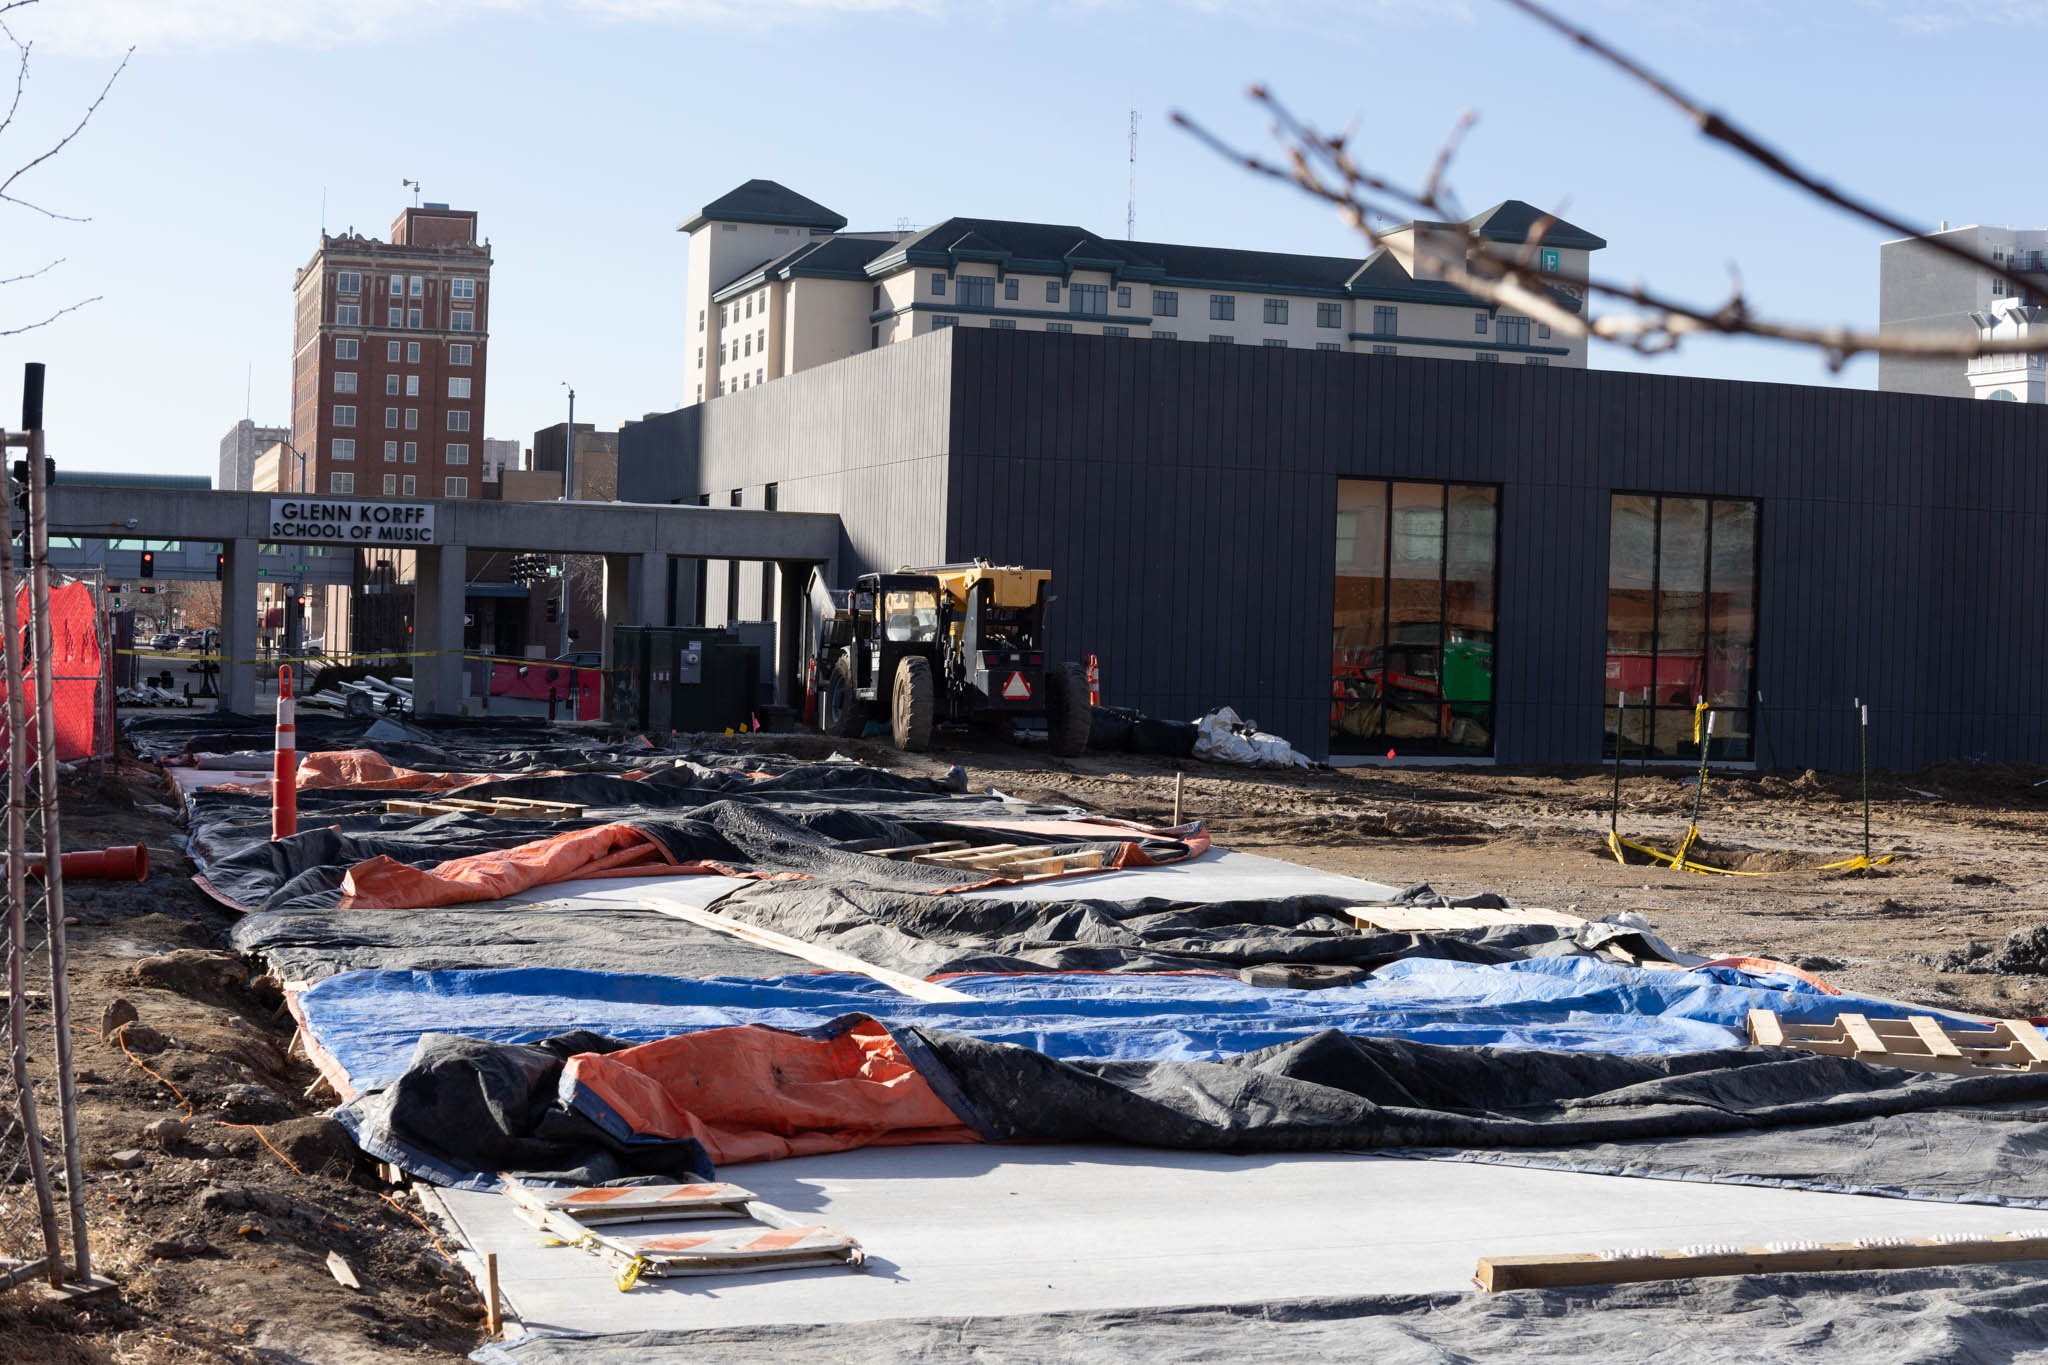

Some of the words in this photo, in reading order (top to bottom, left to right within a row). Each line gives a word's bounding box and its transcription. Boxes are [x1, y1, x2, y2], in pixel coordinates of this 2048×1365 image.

[1546, 254, 1557, 273] E
[282, 502, 352, 522] GLENN
[360, 505, 425, 524] KORFF
[272, 522, 345, 539] SCHOOL
[350, 525, 373, 539] OF
[377, 526, 432, 541] MUSIC
